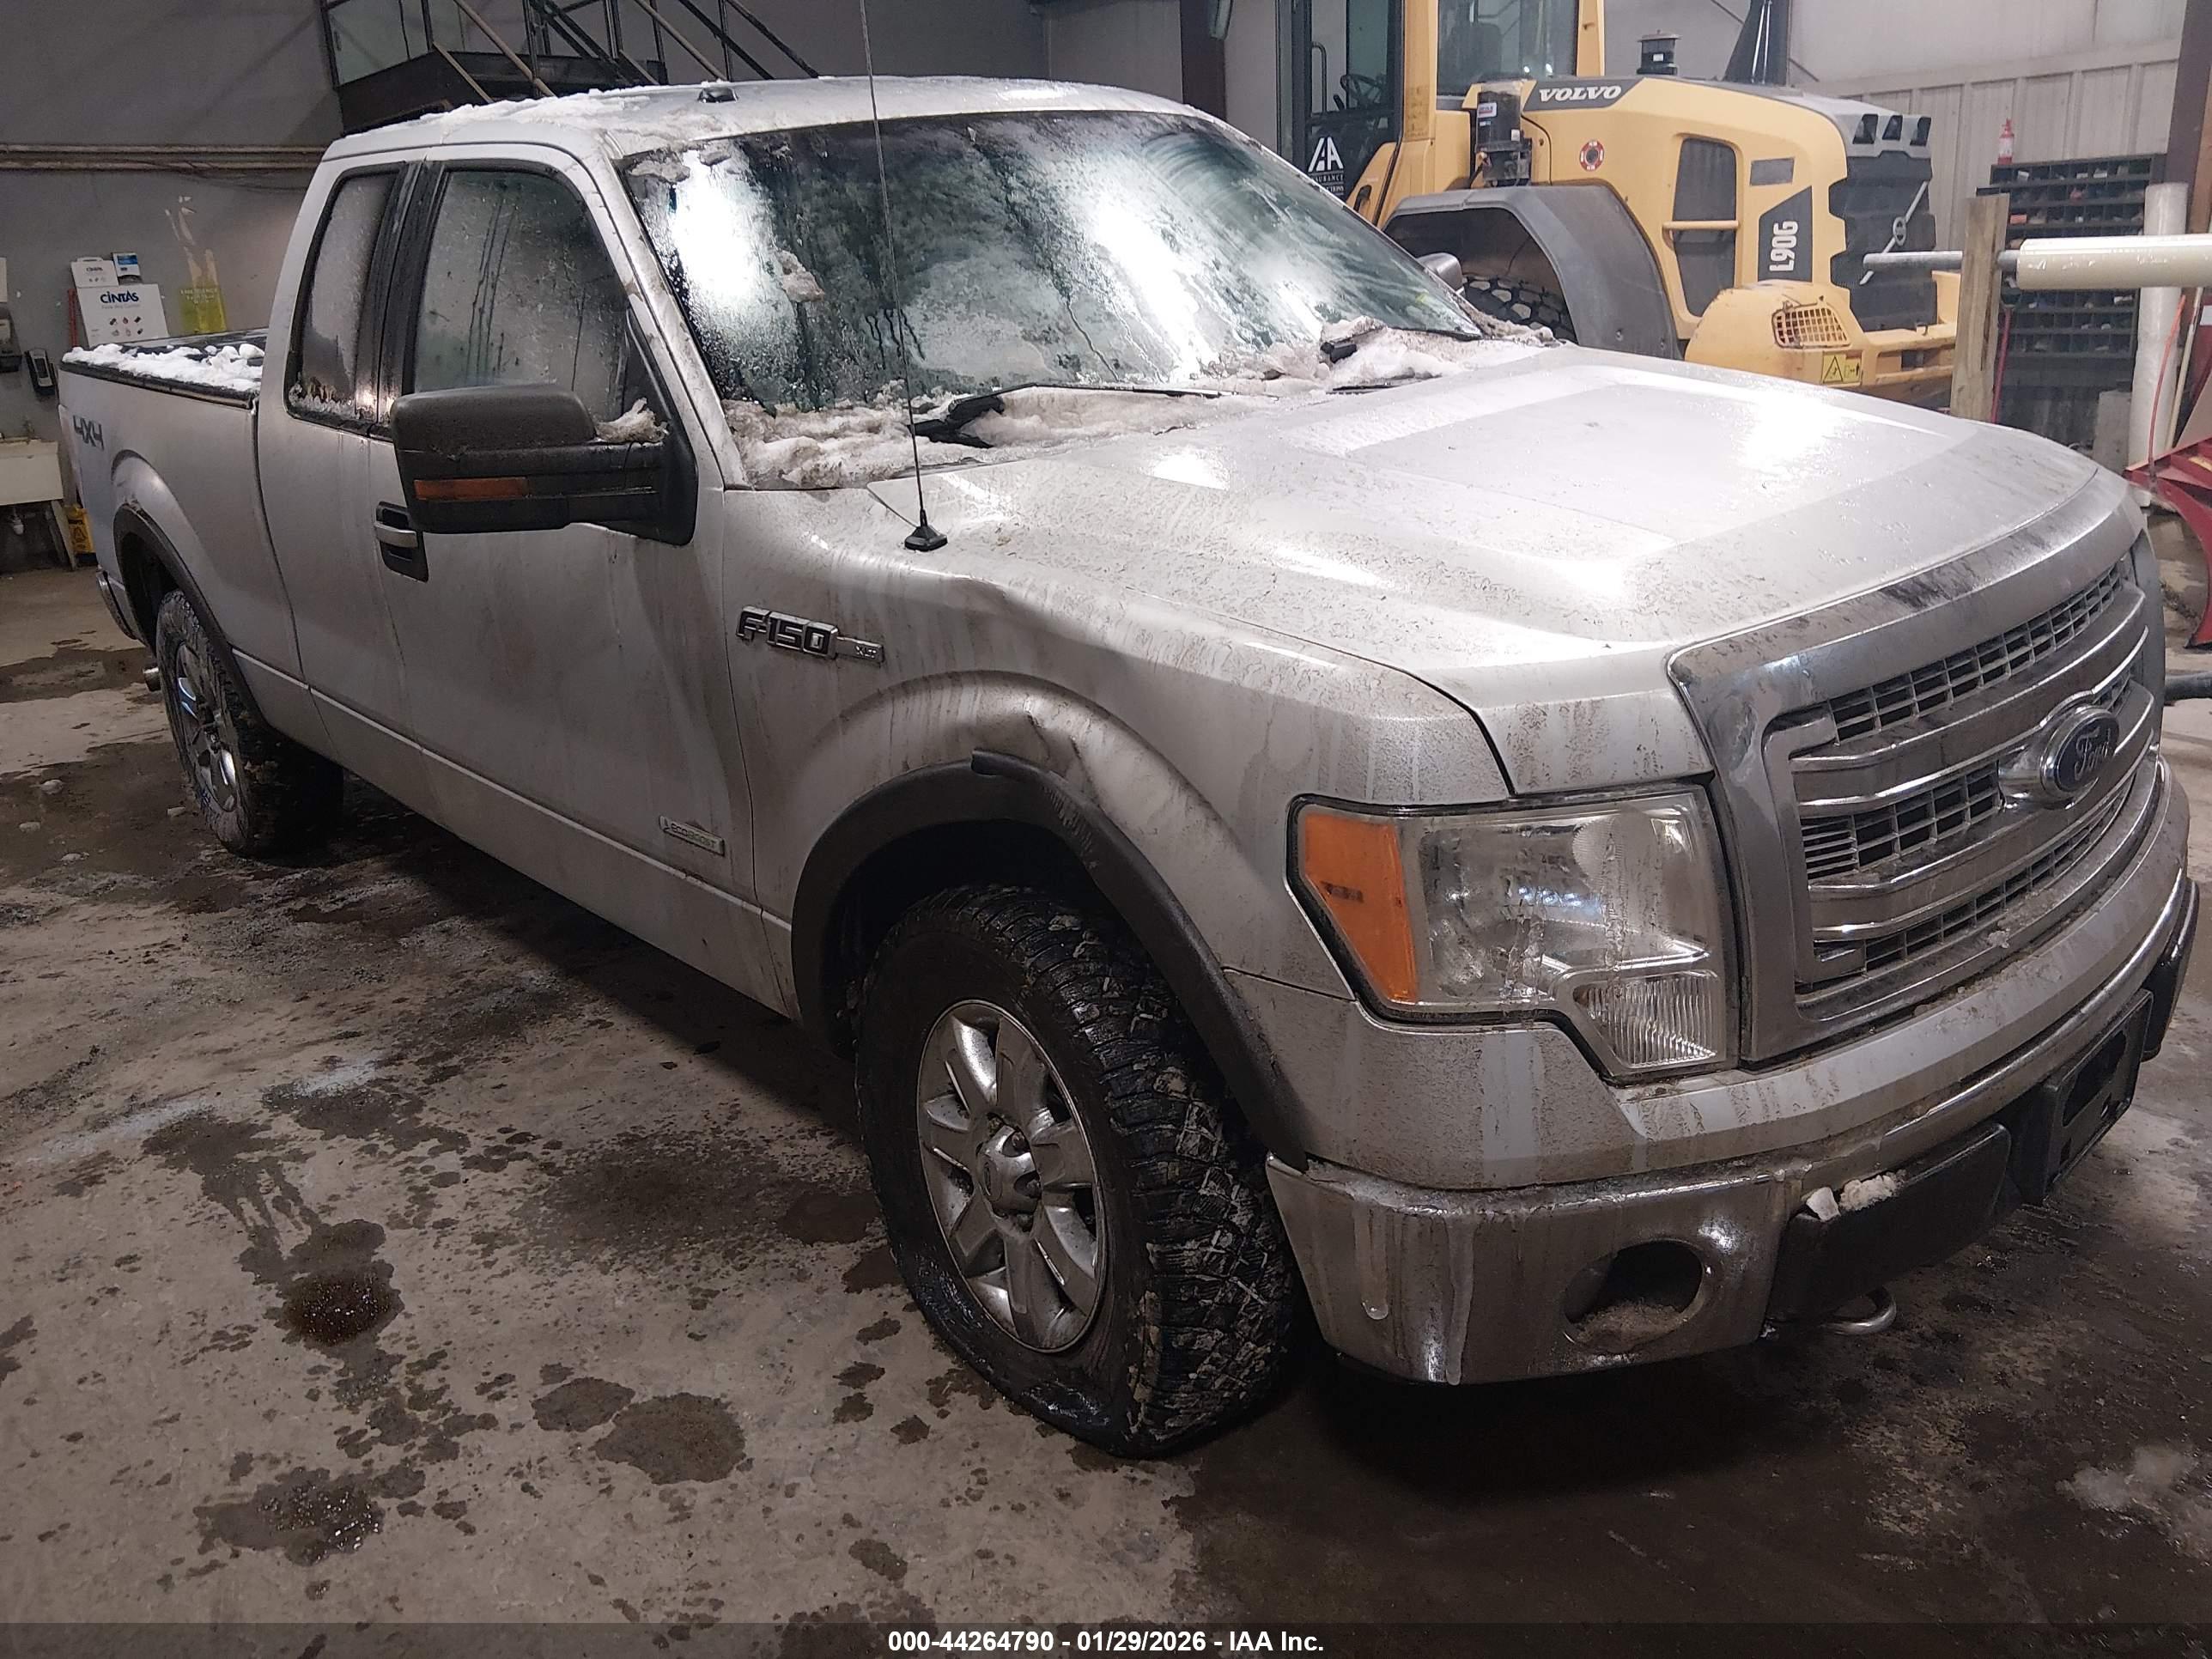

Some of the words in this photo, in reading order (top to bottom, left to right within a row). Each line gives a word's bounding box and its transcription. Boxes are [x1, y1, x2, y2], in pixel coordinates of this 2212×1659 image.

[1538, 85, 1622, 102] VOLVO
[1769, 221, 1799, 271] L90G
[2074, 726, 2112, 781] Ford
